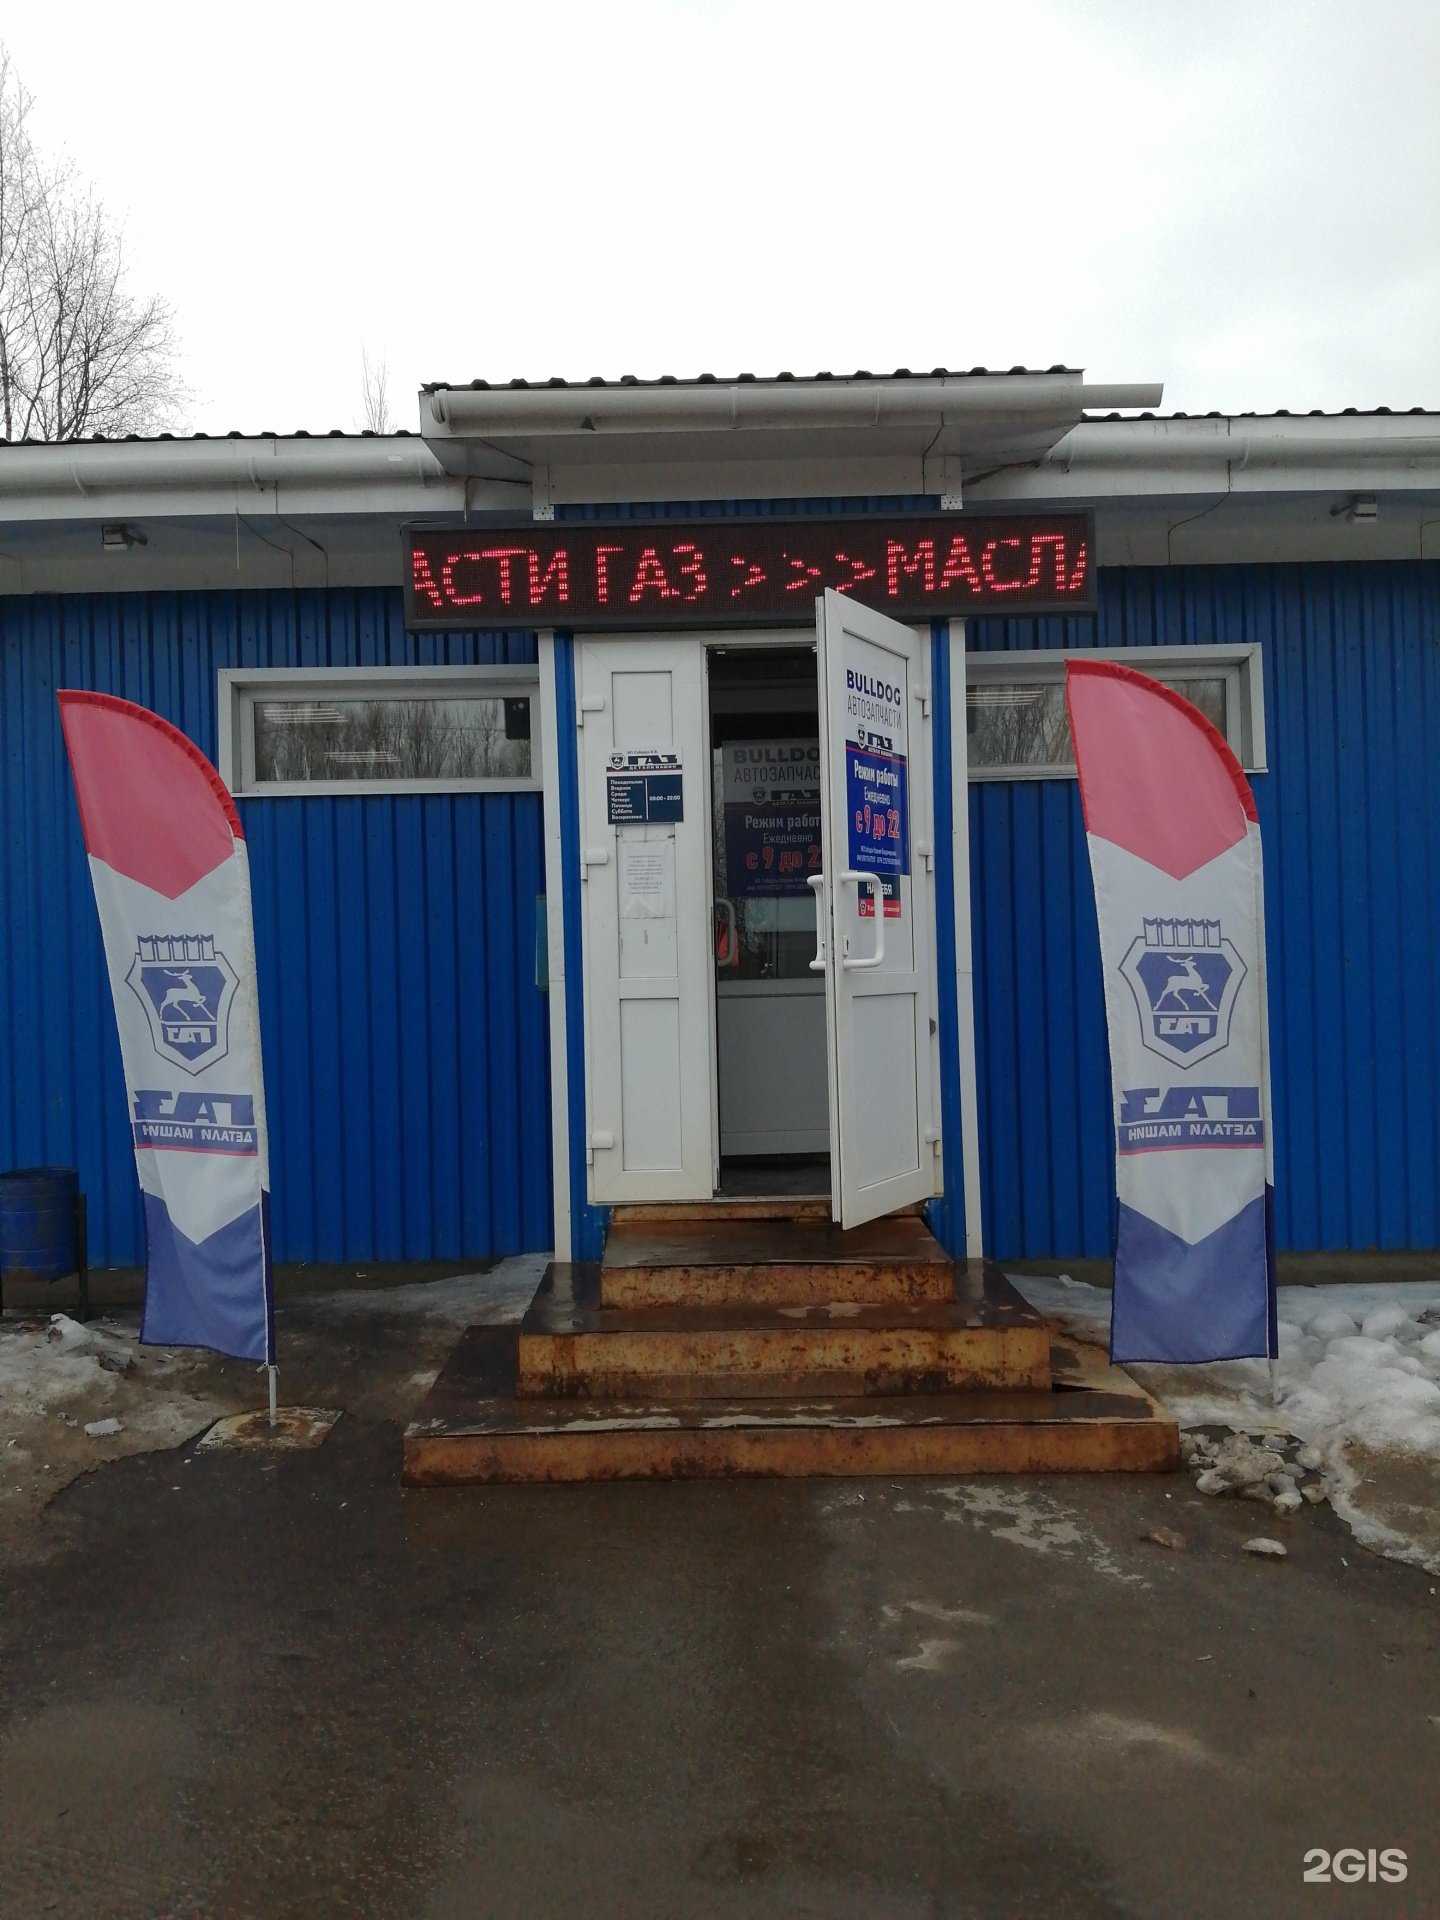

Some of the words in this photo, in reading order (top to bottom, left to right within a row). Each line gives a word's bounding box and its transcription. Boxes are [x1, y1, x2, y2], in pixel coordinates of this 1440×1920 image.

[597, 545, 707, 602] ГАЗ
[846, 668, 901, 706] BULLDOG
[847, 694, 902, 729] АВТОЗАПЧАСТИ
[854, 760, 875, 782] Режим
[876, 767, 898, 788] работы
[745, 814, 784, 829] Режим
[887, 809, 900, 838] 22
